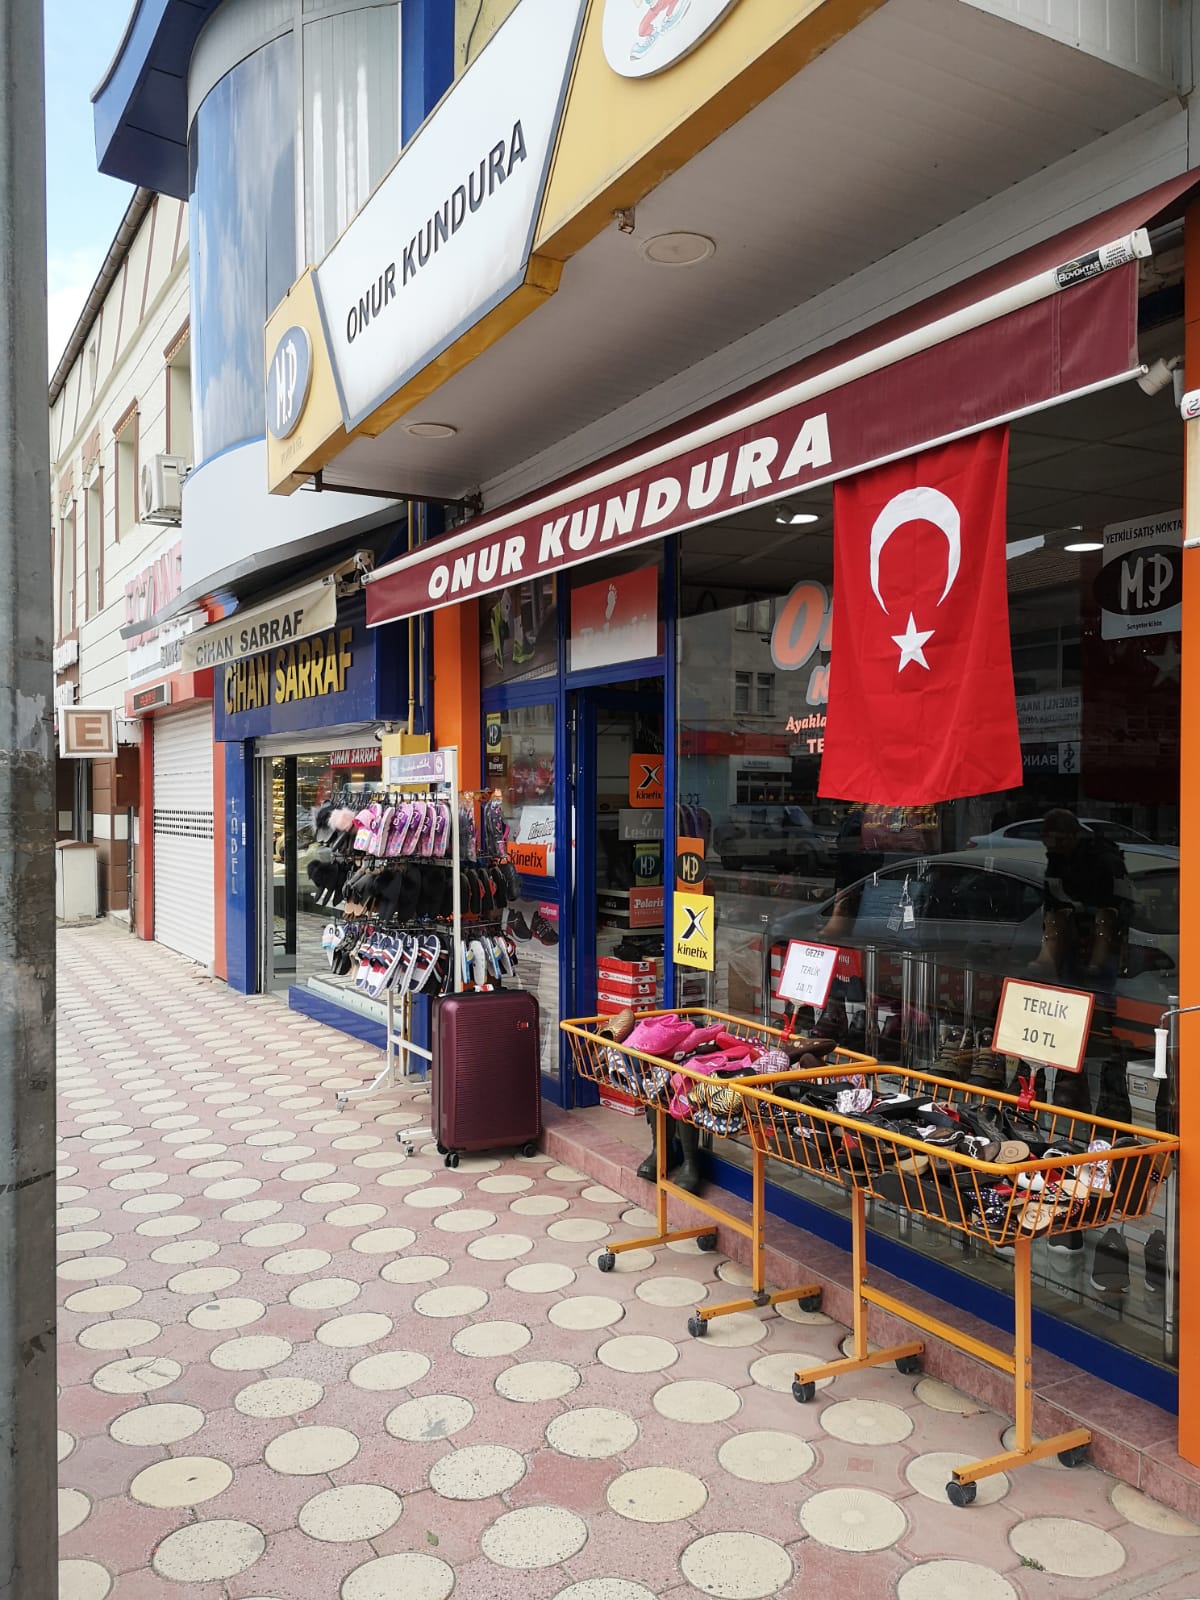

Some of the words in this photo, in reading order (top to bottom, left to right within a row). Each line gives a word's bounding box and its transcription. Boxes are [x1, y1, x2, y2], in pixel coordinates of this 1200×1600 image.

[346, 262, 397, 344] ONUR
[402, 118, 528, 287] KUNDURA
[427, 535, 526, 600] ONUR
[536, 412, 833, 564] KUNDURA
[1105, 527, 1133, 545] YETKİLİ
[1133, 524, 1155, 539] SATIŞ
[195, 634, 234, 667] CİHAN
[239, 608, 304, 653] SARRAF
[224, 652, 270, 716] CİHAN
[274, 625, 353, 705] SARRAF
[75, 717, 104, 747] E
[351, 747, 380, 765] SARRAF
[635, 790, 662, 801] kinetix
[510, 848, 543, 869] kinetix
[677, 942, 708, 961] kinetix
[1023, 996, 1069, 1020] TERLİK
[1022, 1027, 1039, 1044] 10
[1042, 1031, 1056, 1049] TL
